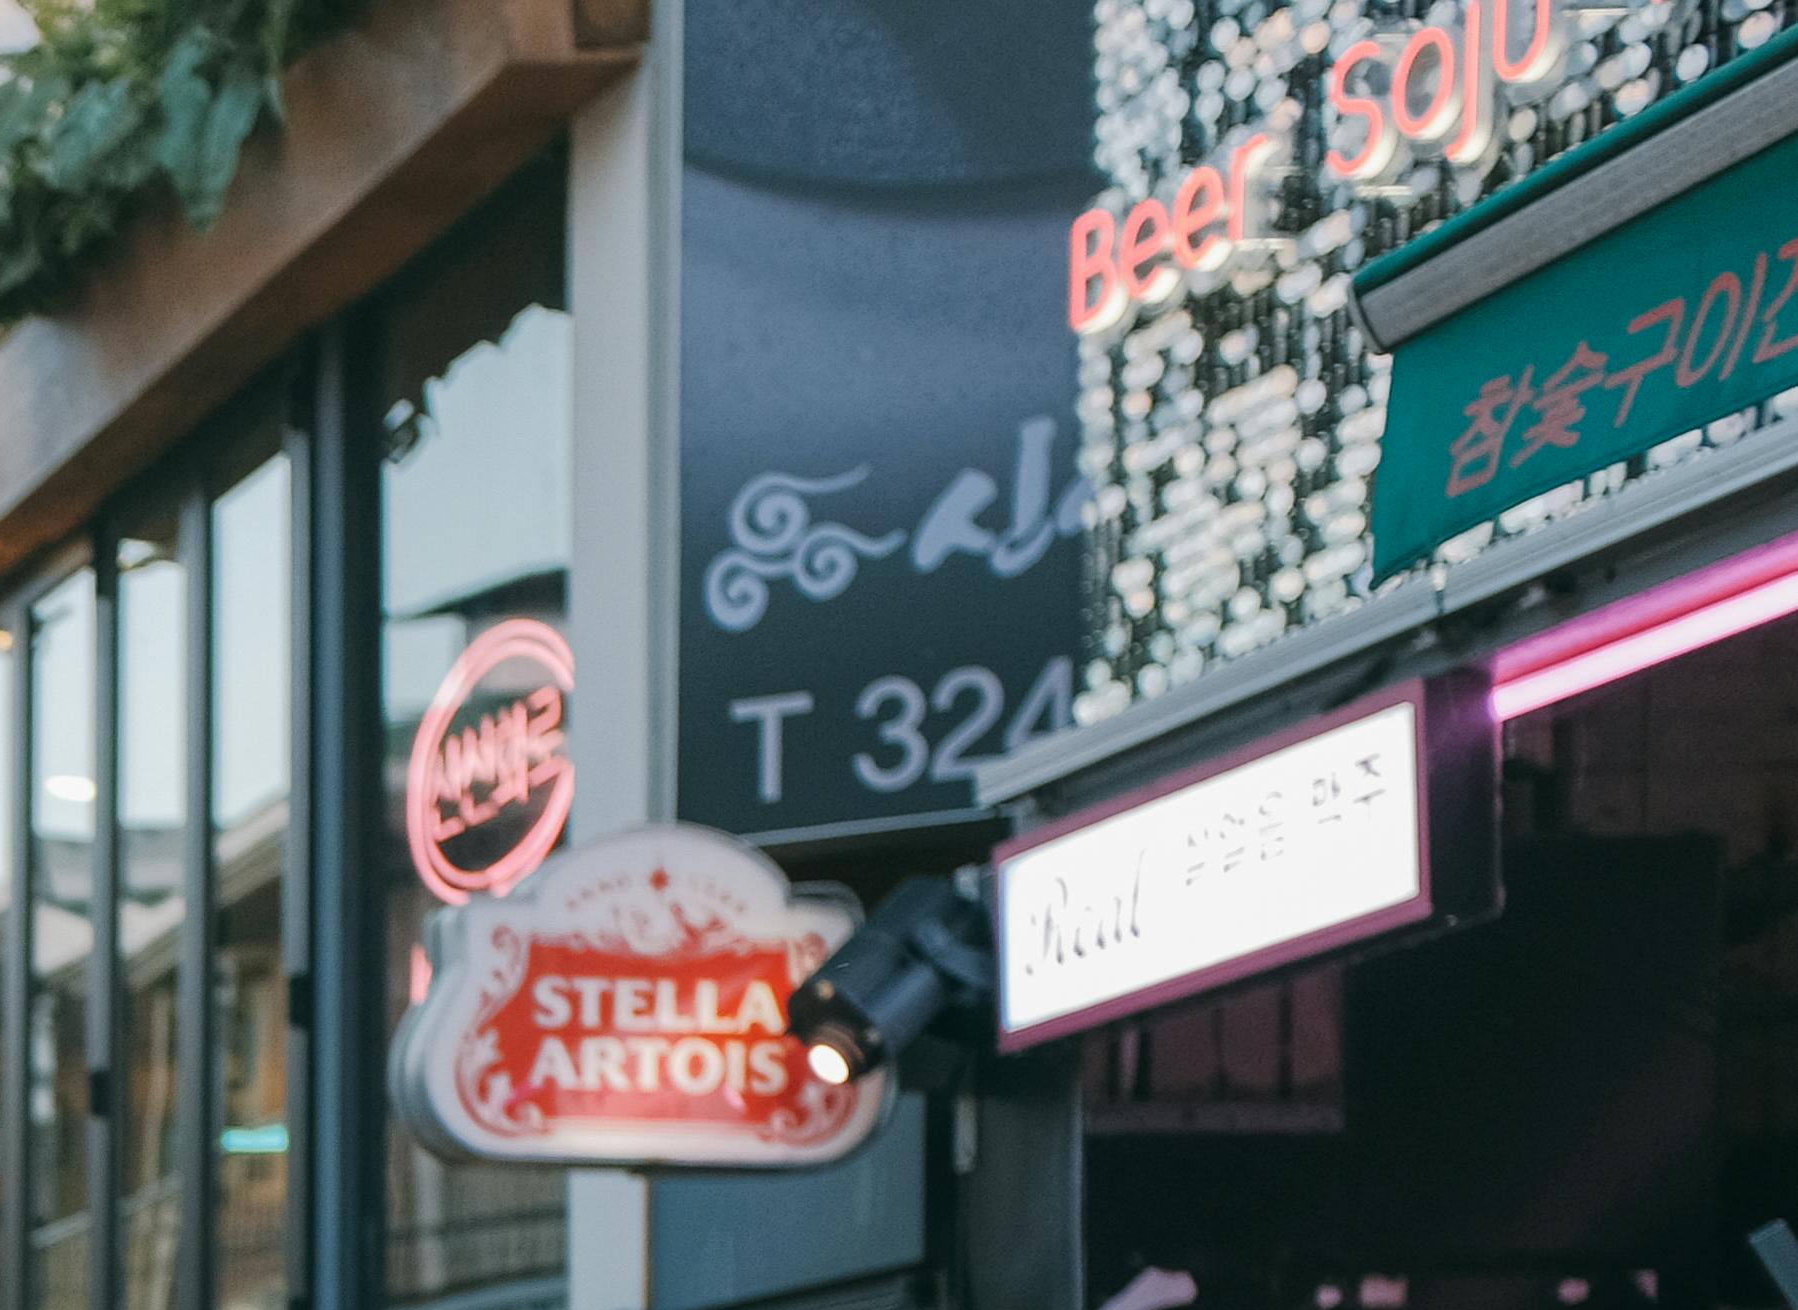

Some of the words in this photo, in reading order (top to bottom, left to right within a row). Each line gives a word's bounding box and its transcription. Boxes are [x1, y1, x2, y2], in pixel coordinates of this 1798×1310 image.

[1068, 134, 1266, 330] Beer
[912, 415, 1096, 578] 신
[731, 690, 815, 803] T
[531, 972, 787, 1037] STELLA
[528, 1033, 791, 1097] ARTOIS
